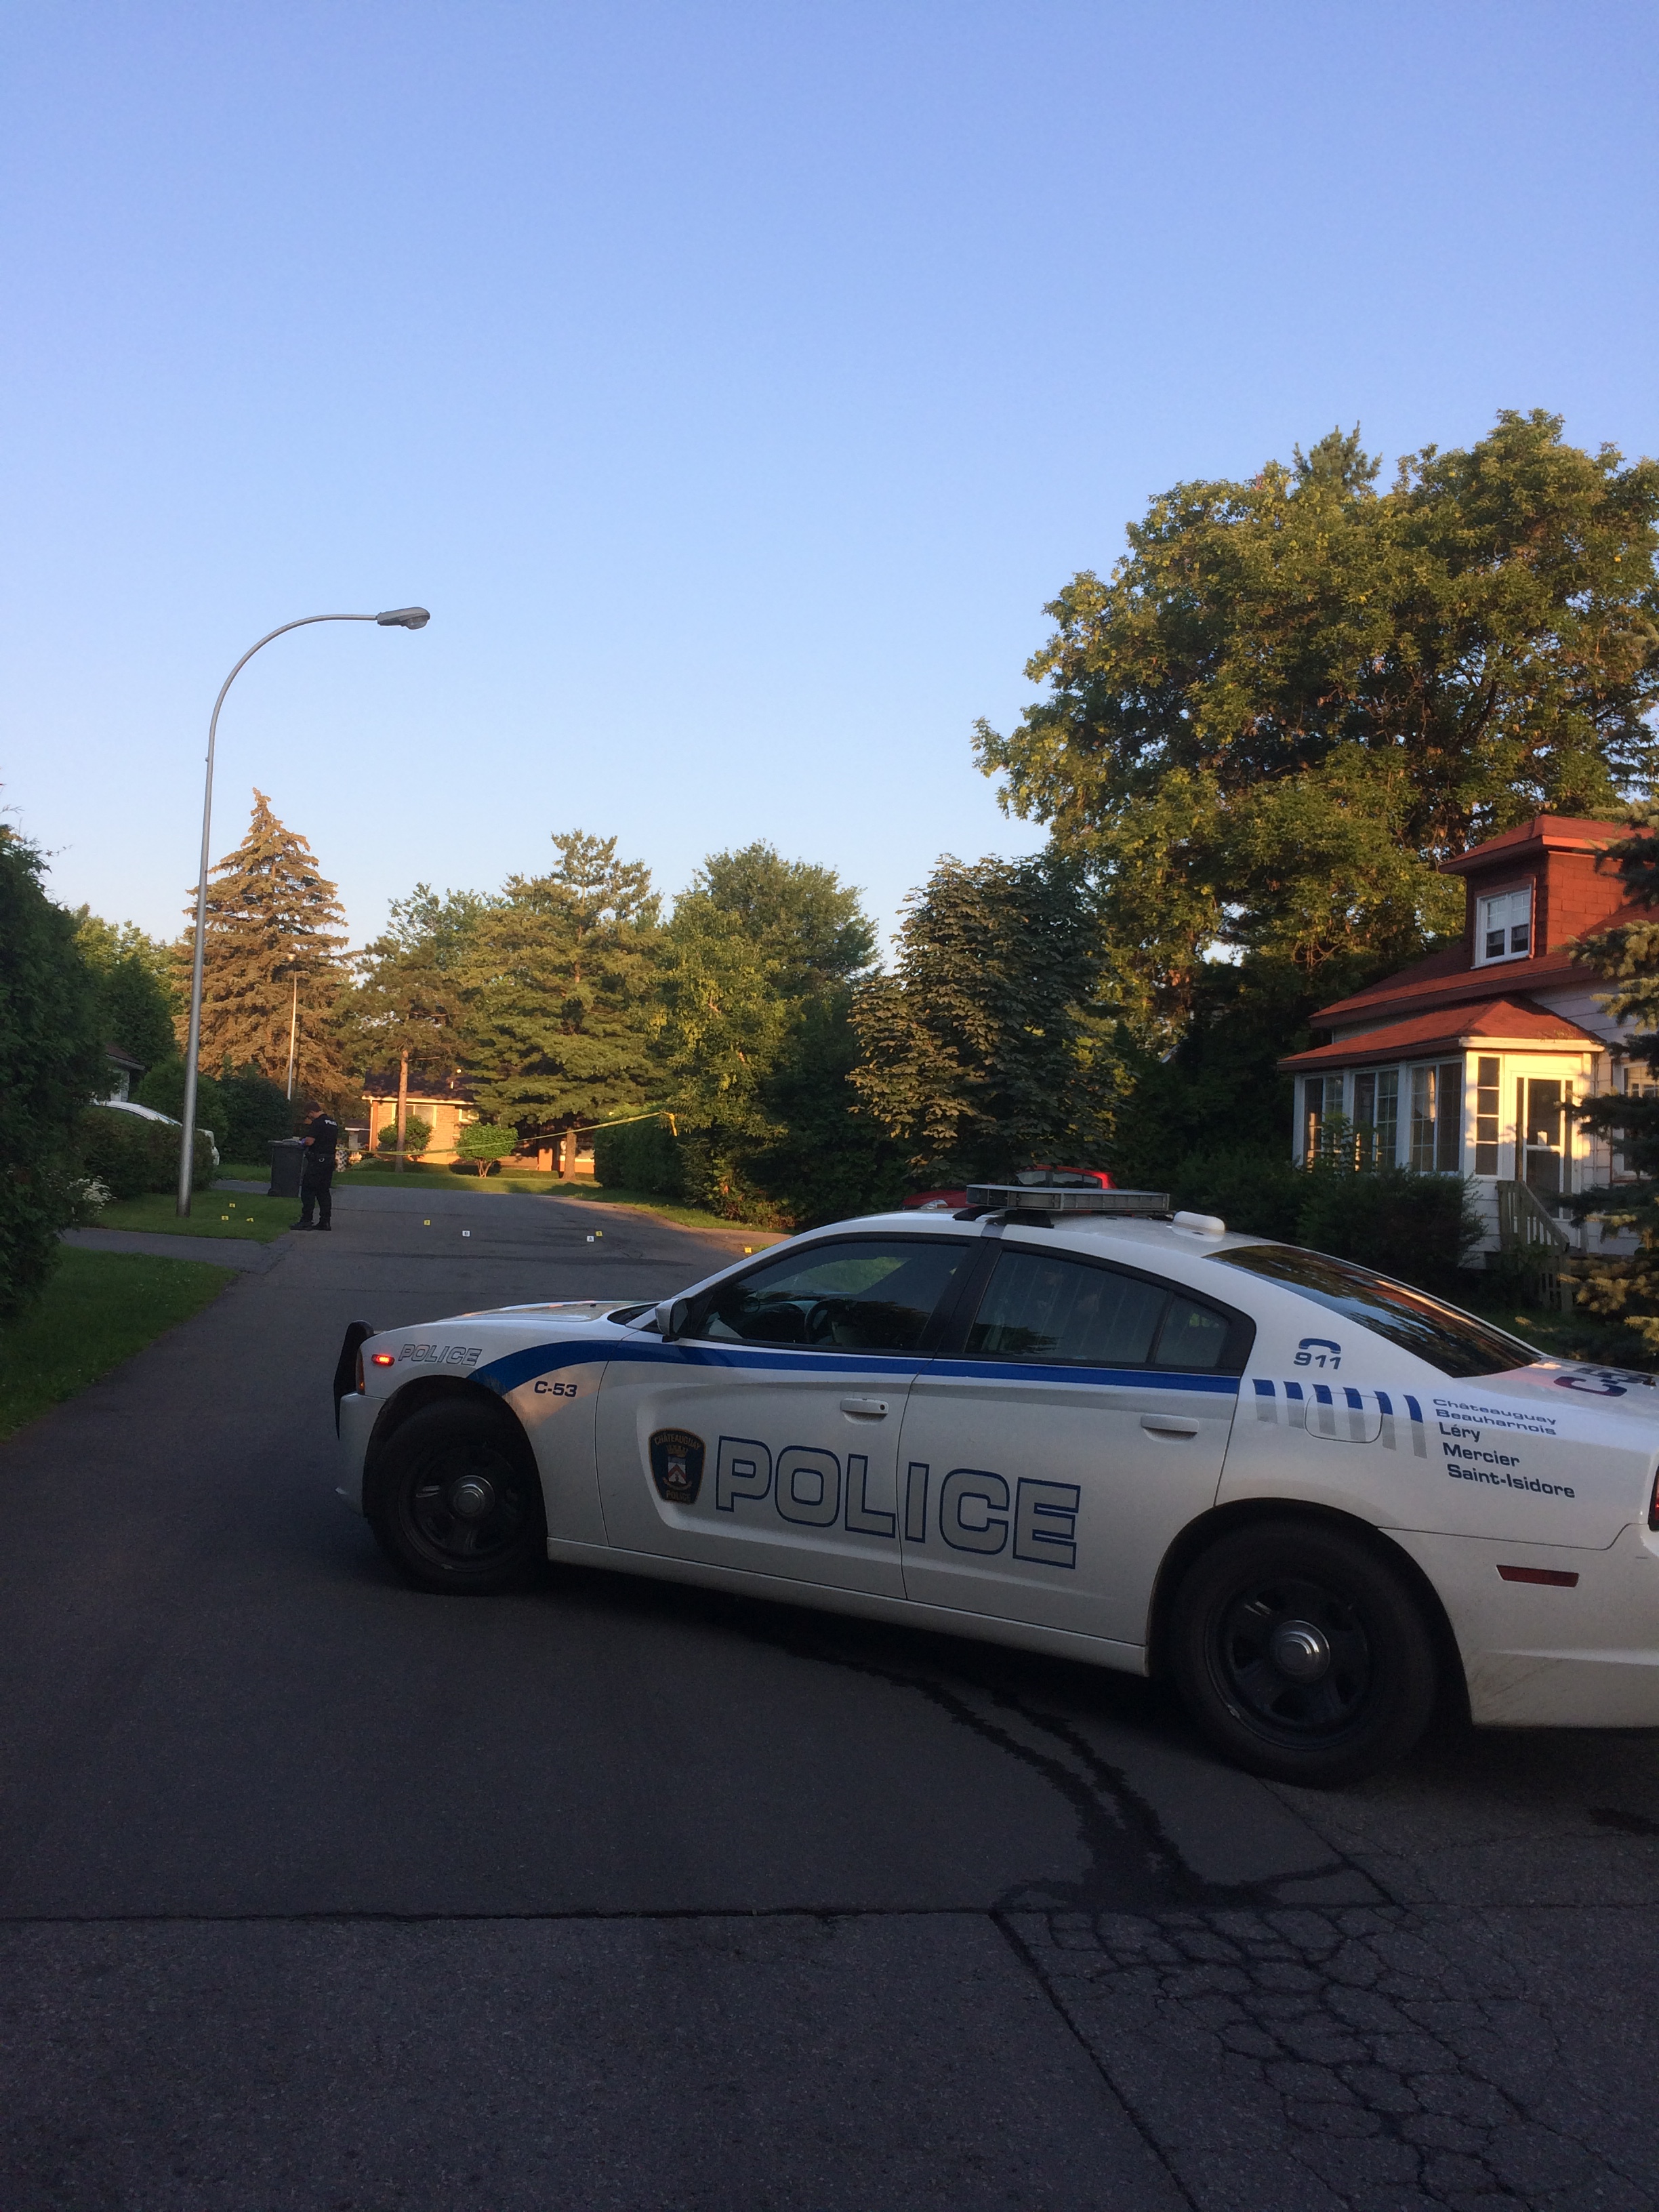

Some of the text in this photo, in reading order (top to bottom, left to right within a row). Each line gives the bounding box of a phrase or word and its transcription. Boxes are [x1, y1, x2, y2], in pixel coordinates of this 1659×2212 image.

[398, 1344, 483, 1366] POLICE
[1293, 1352, 1341, 1370] 911
[535, 1380, 577, 1397] C-53
[1433, 1398, 1557, 1425] Châteauguay
[1435, 1408, 1557, 1435] Beauharnois
[1439, 1421, 1480, 1443] Léry
[1442, 1441, 1520, 1467] Mercier
[1447, 1463, 1575, 1498] Saint-Isidore
[666, 1490, 691, 1502] POLICE
[716, 1435, 1081, 1570] POLICE
